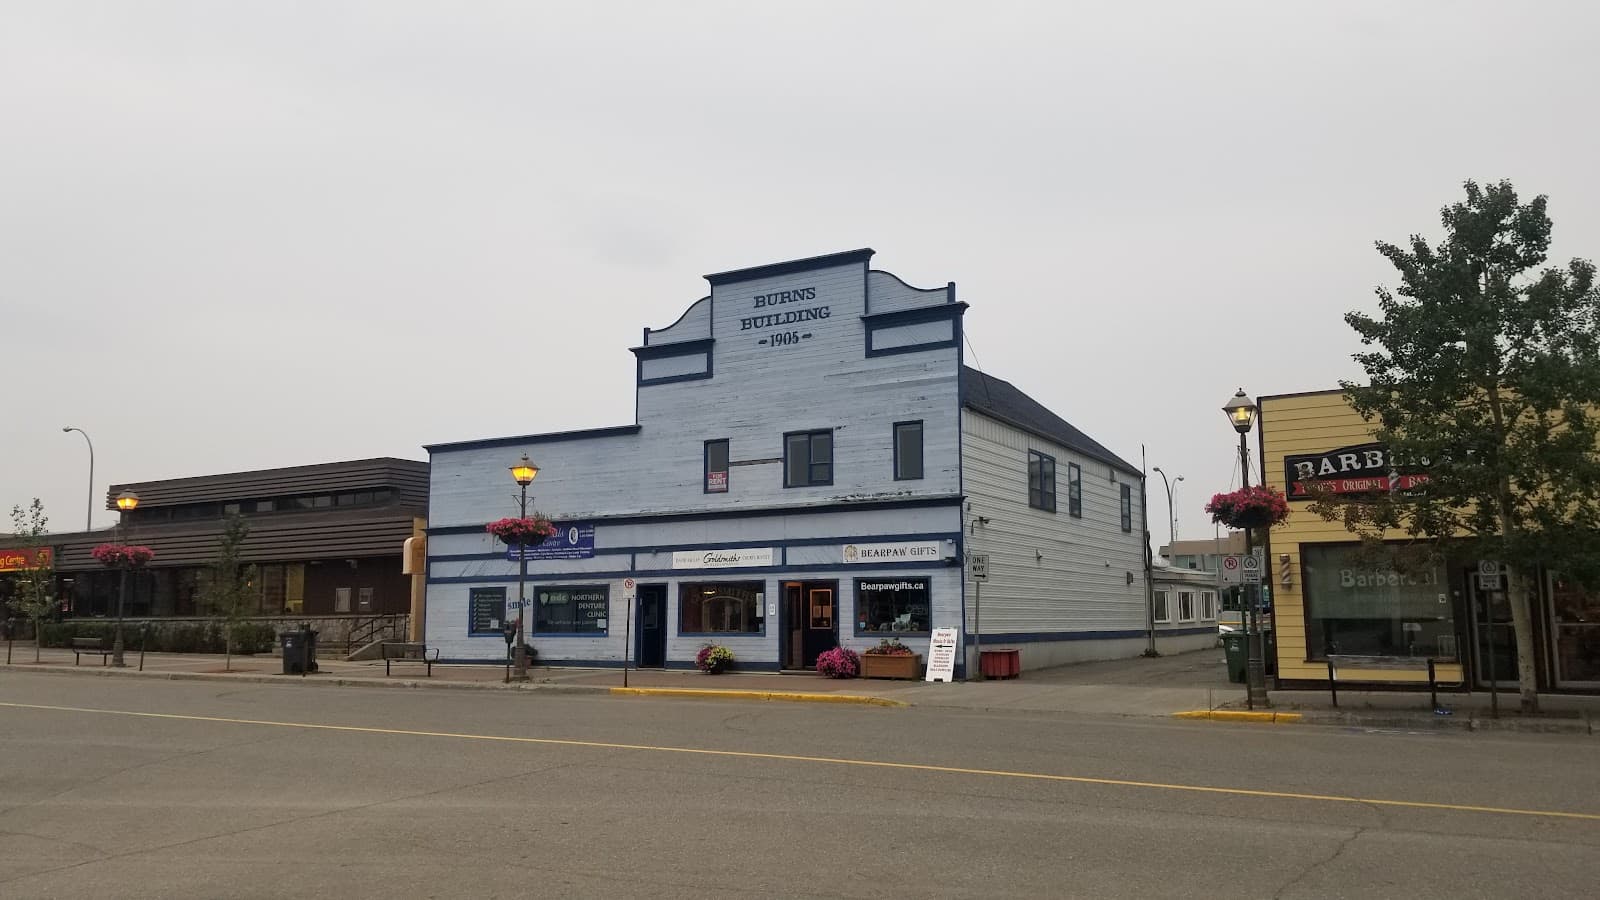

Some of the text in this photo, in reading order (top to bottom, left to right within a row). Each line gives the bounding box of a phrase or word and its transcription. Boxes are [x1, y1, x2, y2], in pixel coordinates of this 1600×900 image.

[753, 287, 816, 308] BURNS
[740, 306, 831, 331] BUILDING
[703, 552, 741, 564] Goldsmiths
[860, 546, 937, 558] BEARPAW GIFTS
[972, 555, 985, 564] ONE
[972, 564, 985, 572] WAY
[860, 582, 924, 592] Bearpawgifts.ca
[571, 593, 605, 601] NORTHERN
[507, 597, 531, 610] smle
